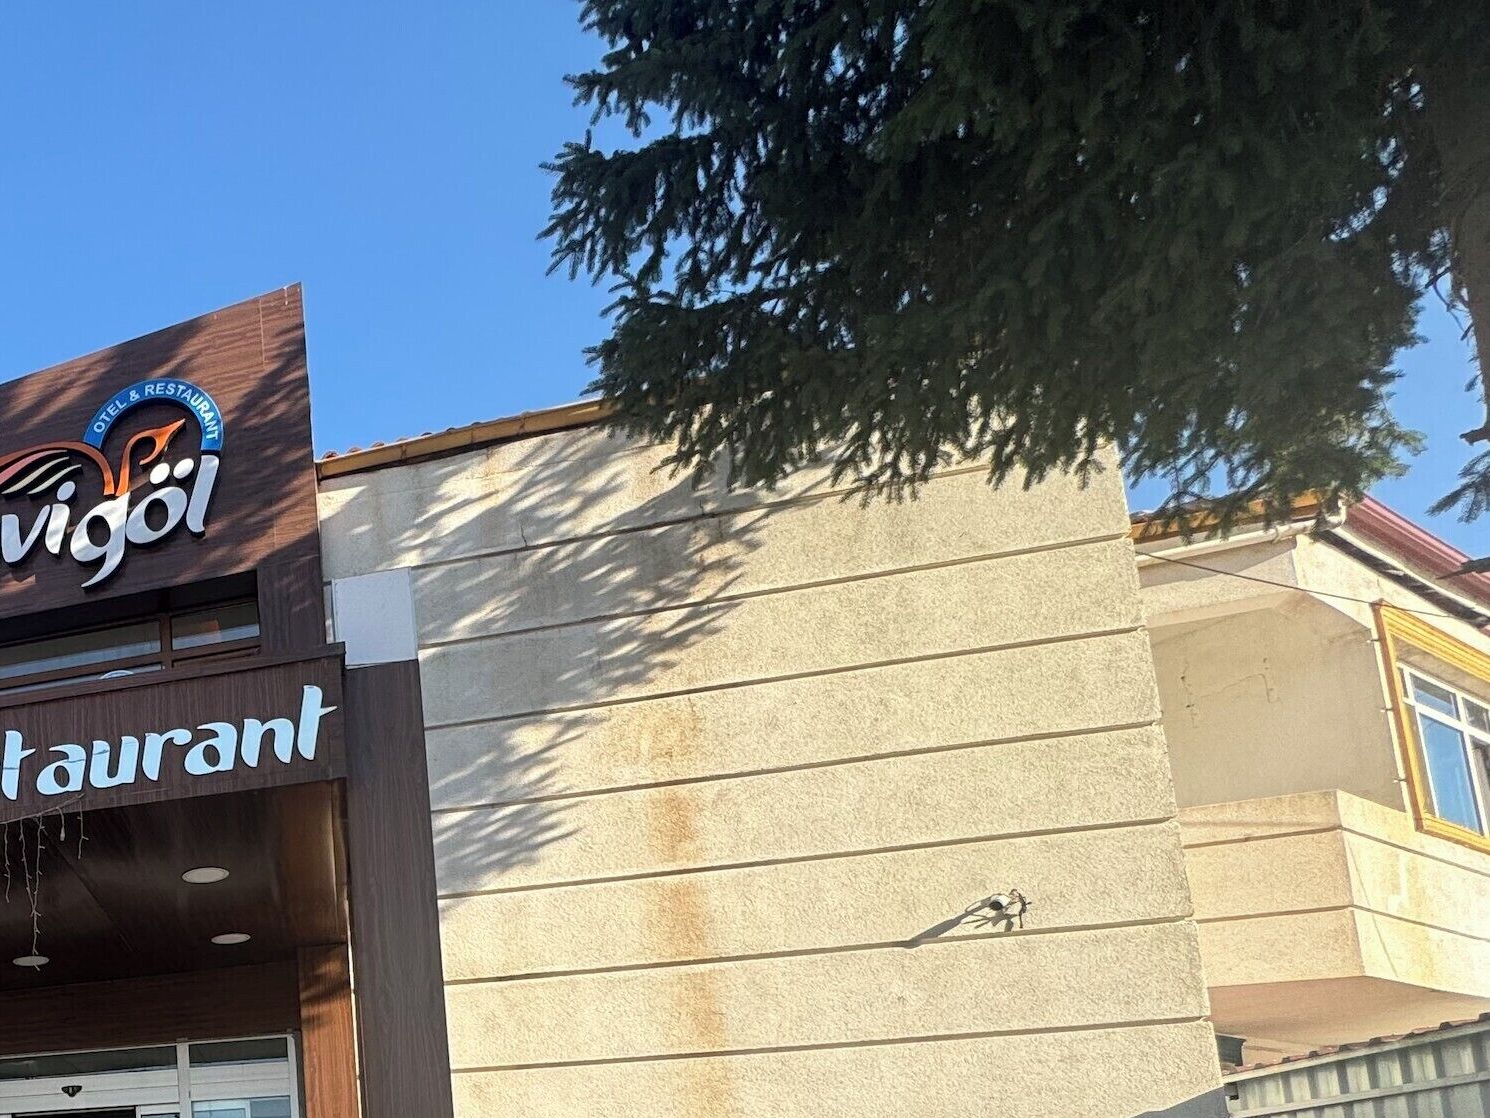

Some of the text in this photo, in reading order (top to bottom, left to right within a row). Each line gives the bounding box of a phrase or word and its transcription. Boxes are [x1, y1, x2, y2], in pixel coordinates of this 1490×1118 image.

[93, 383, 219, 440] OTEL & RESTAURANT
